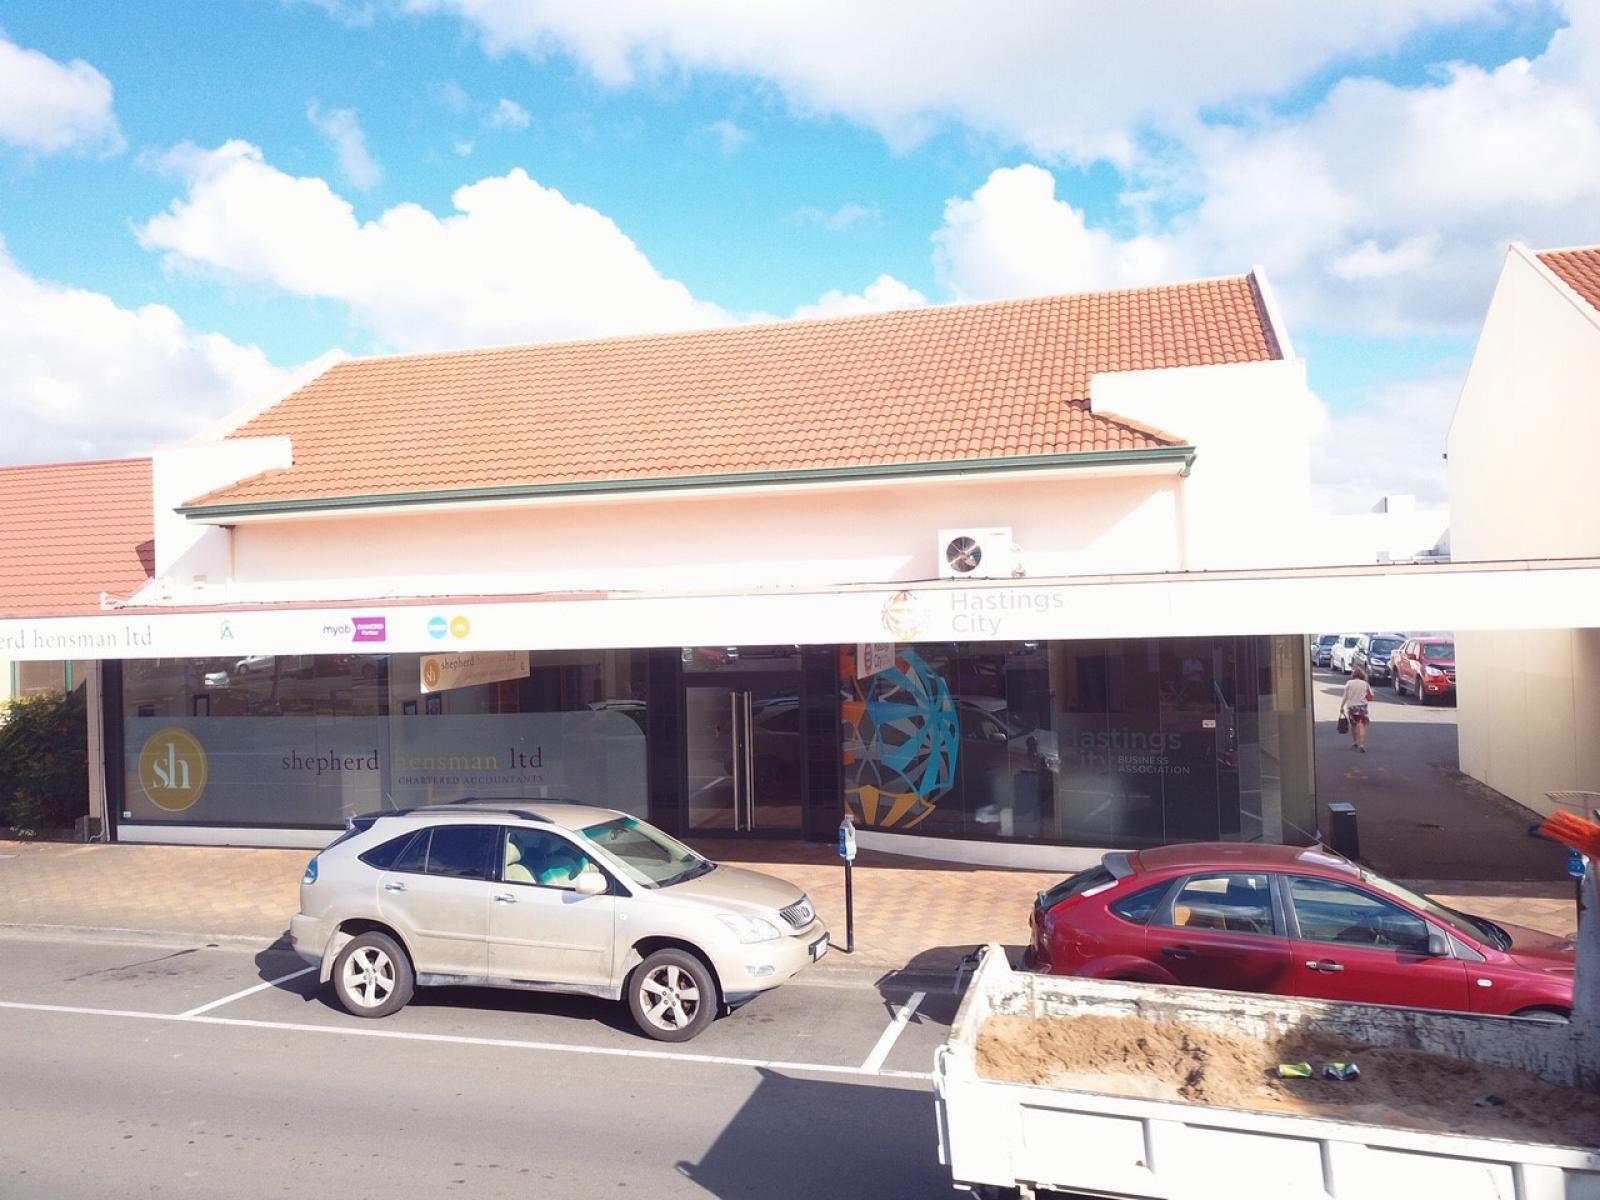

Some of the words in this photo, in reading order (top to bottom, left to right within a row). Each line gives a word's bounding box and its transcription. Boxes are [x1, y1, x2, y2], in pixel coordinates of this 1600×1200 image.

[951, 589, 1064, 613] Hastings
[323, 624, 351, 637] myob
[951, 612, 1002, 637] City
[33, 629, 117, 649] hensman
[126, 625, 152, 646] ltd
[153, 743, 192, 789] sh
[281, 750, 380, 775] shepherd
[393, 751, 499, 770] hensman
[510, 747, 544, 768] ltd
[1117, 755, 1169, 765] BUSINESS
[1117, 765, 1191, 774] ASSOCIATION
[398, 775, 460, 785] CHARTERED
[463, 774, 544, 785] ACCOUNTANTS
